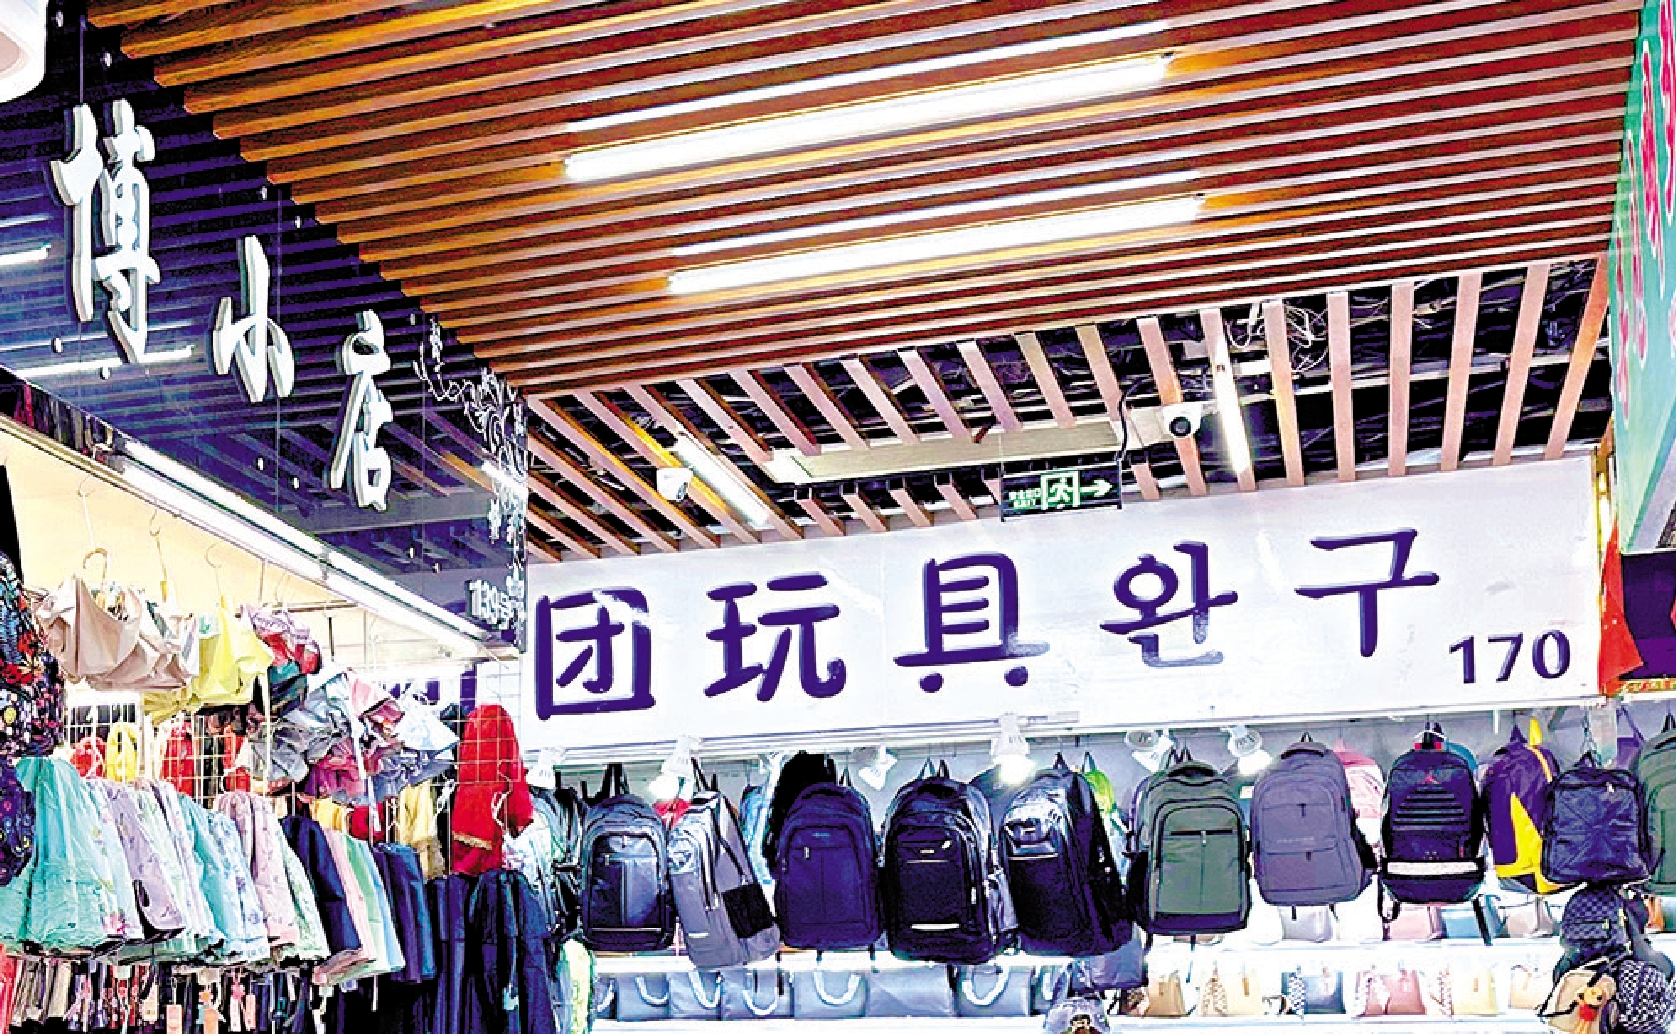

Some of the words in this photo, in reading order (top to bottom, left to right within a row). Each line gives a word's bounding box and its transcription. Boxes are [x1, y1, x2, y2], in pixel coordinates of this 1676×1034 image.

[533, 555, 1049, 720] 团玩具
[1101, 529, 1440, 667] 완구
[1451, 632, 1570, 683] 170
